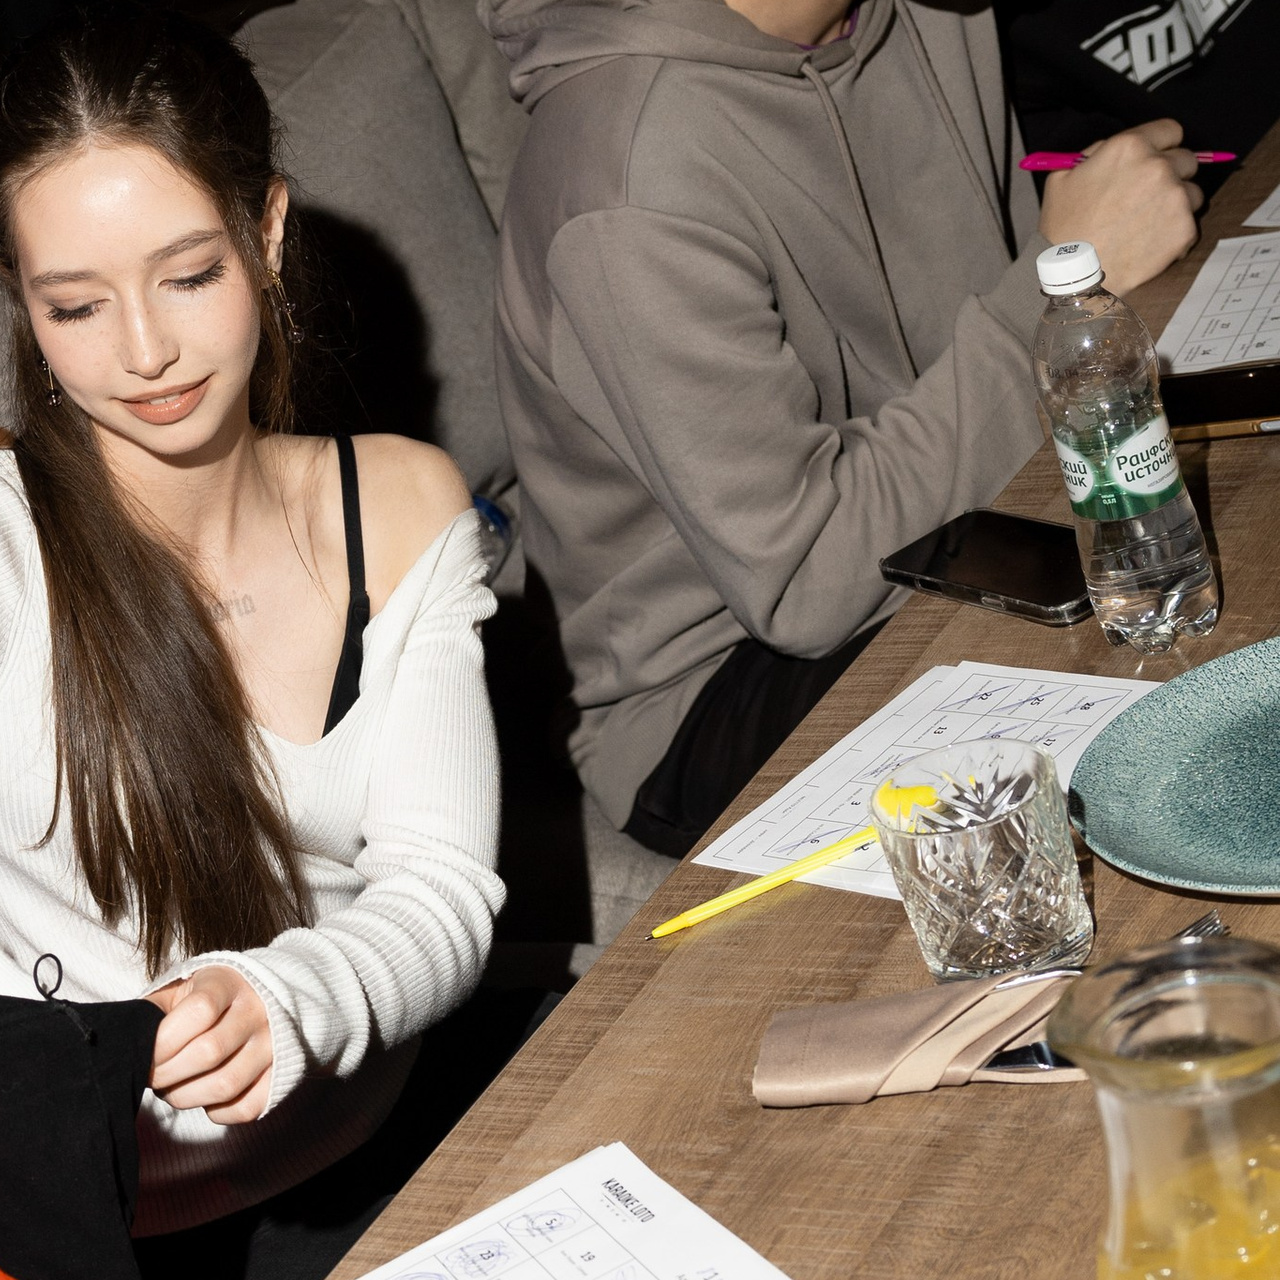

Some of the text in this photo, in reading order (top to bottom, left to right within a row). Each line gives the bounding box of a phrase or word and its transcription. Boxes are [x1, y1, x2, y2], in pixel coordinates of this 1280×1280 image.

[977, 691, 993, 701] 22
[1030, 696, 1045, 706] 25
[933, 725, 948, 735] 13
[1043, 737, 1056, 747] 17
[601, 1177, 640, 1209] KARAOKE
[629, 1203, 656, 1223] LOTO
[479, 1249, 495, 1261] 23
[580, 1251, 596, 1263] 19
